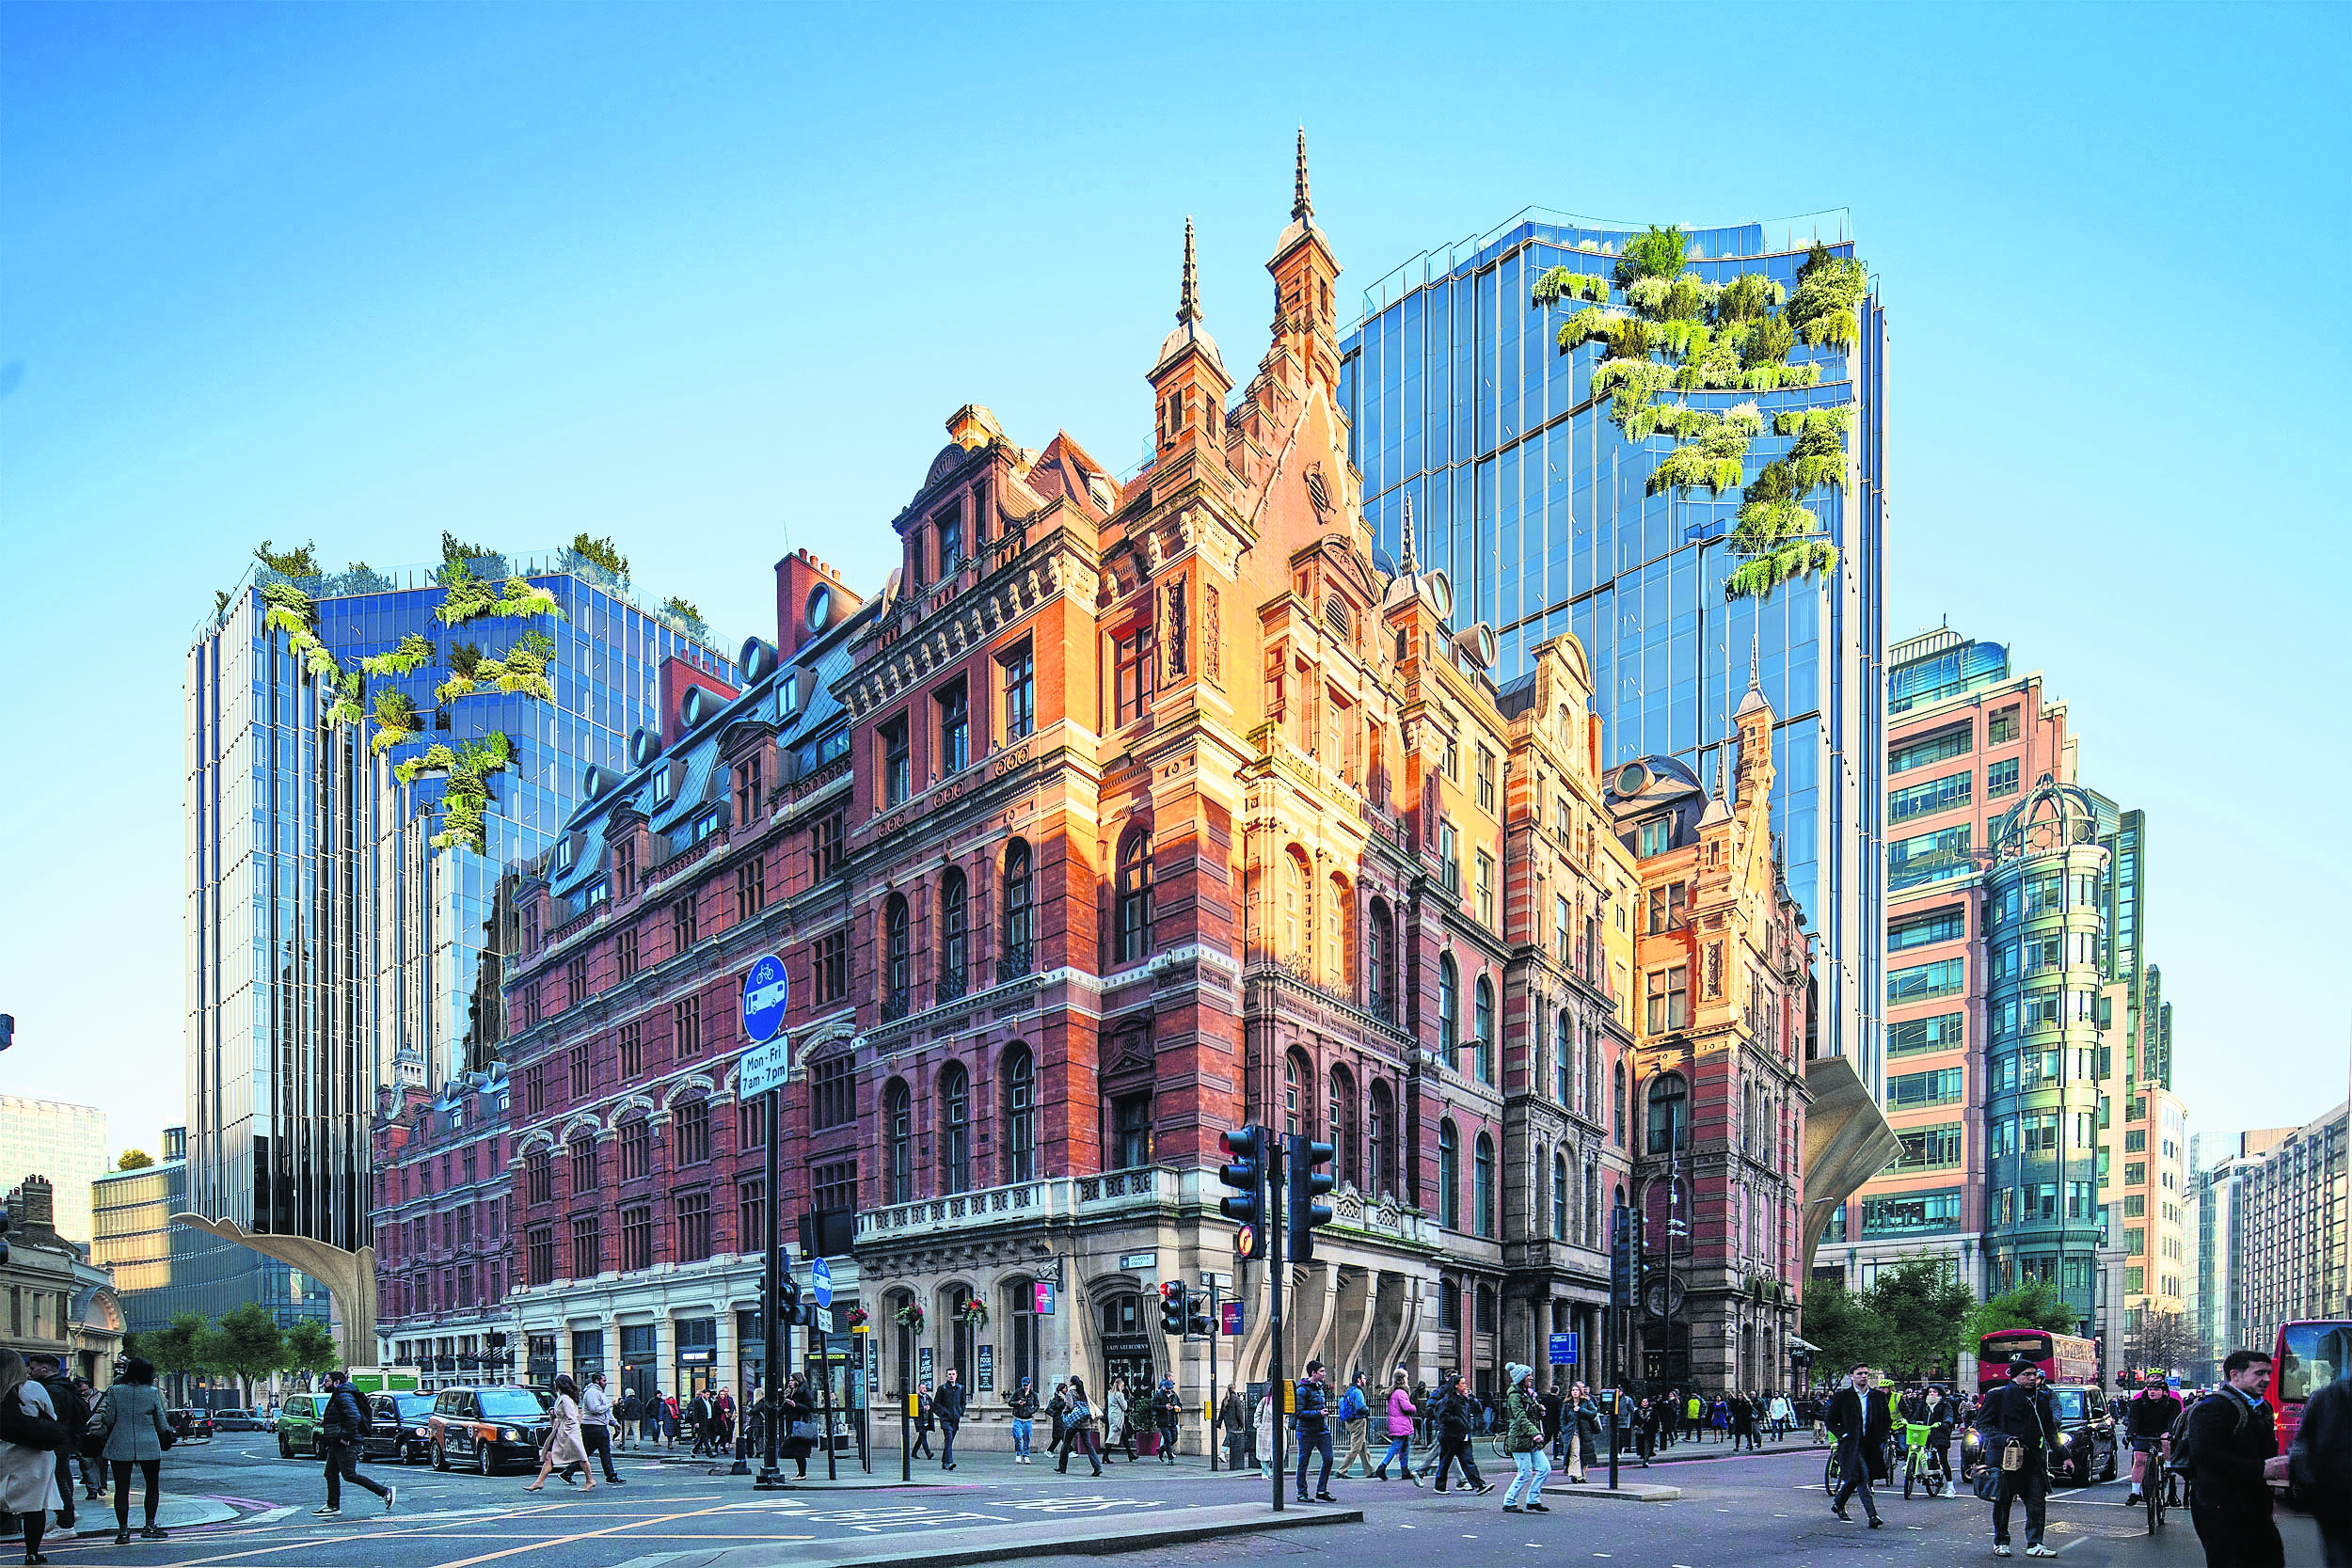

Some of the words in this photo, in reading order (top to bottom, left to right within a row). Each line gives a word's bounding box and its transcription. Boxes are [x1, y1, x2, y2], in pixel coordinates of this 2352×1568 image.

[747, 1056, 764, 1072] Mon
[770, 1044, 781, 1062] Fri
[2010, 1353, 2022, 1362] 47
